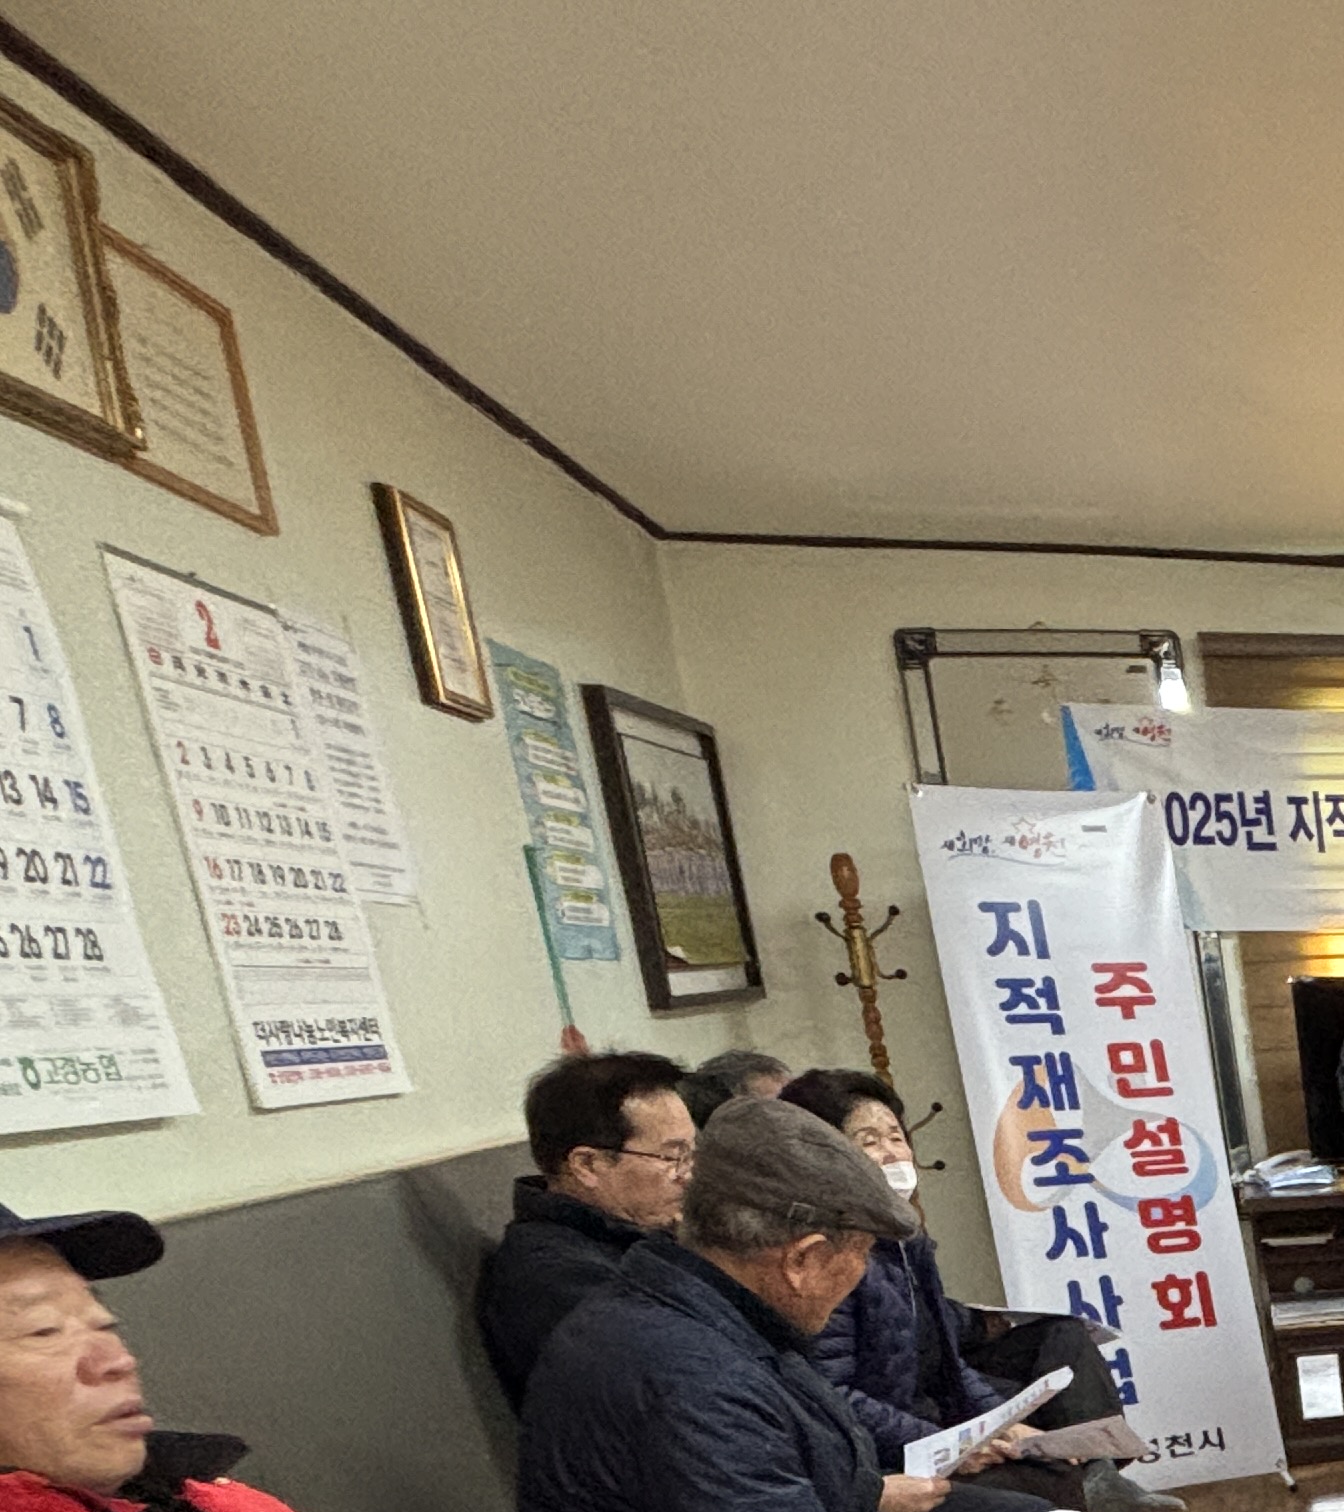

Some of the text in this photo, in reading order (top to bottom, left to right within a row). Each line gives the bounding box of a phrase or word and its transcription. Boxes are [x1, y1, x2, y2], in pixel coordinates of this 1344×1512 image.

[22, 625, 43, 662] 1
[194, 600, 221, 650] 2
[8, 694, 67, 739] 7 8
[28, 774, 59, 811] 14
[62, 779, 92, 816] 15
[1165, 789, 1278, 851] 025년
[15, 846, 50, 885] 20
[53, 851, 80, 887] 21
[82, 854, 114, 890] 22
[9, 922, 44, 960] 26
[43, 924, 72, 961] 27
[74, 926, 105, 962] 28
[1090, 961, 1218, 1331] 주민설명회
